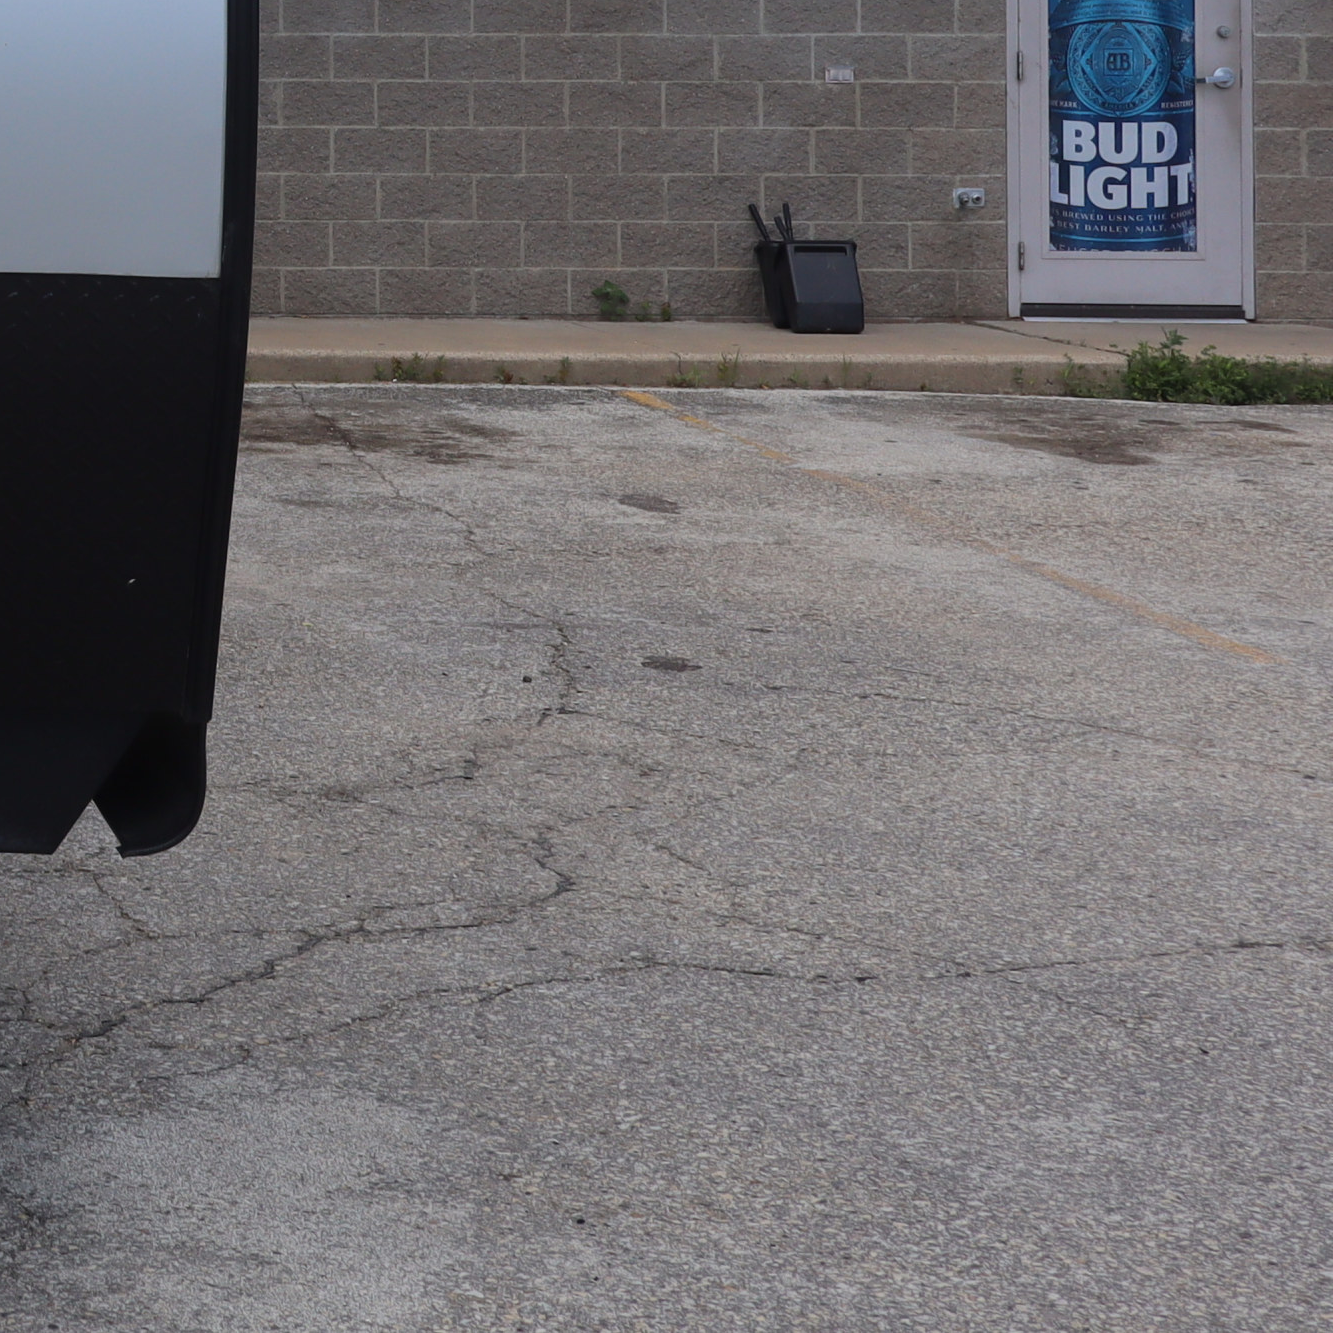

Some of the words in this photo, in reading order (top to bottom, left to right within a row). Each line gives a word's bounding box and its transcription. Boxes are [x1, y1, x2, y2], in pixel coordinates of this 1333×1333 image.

[1062, 120, 1178, 164] BUD
[1049, 161, 1193, 210] LIGHT
[1062, 210, 1104, 221] BREWED
[1108, 214, 1144, 222] USING
[1148, 213, 1165, 221] THE
[1084, 224, 1130, 233] BARLEY
